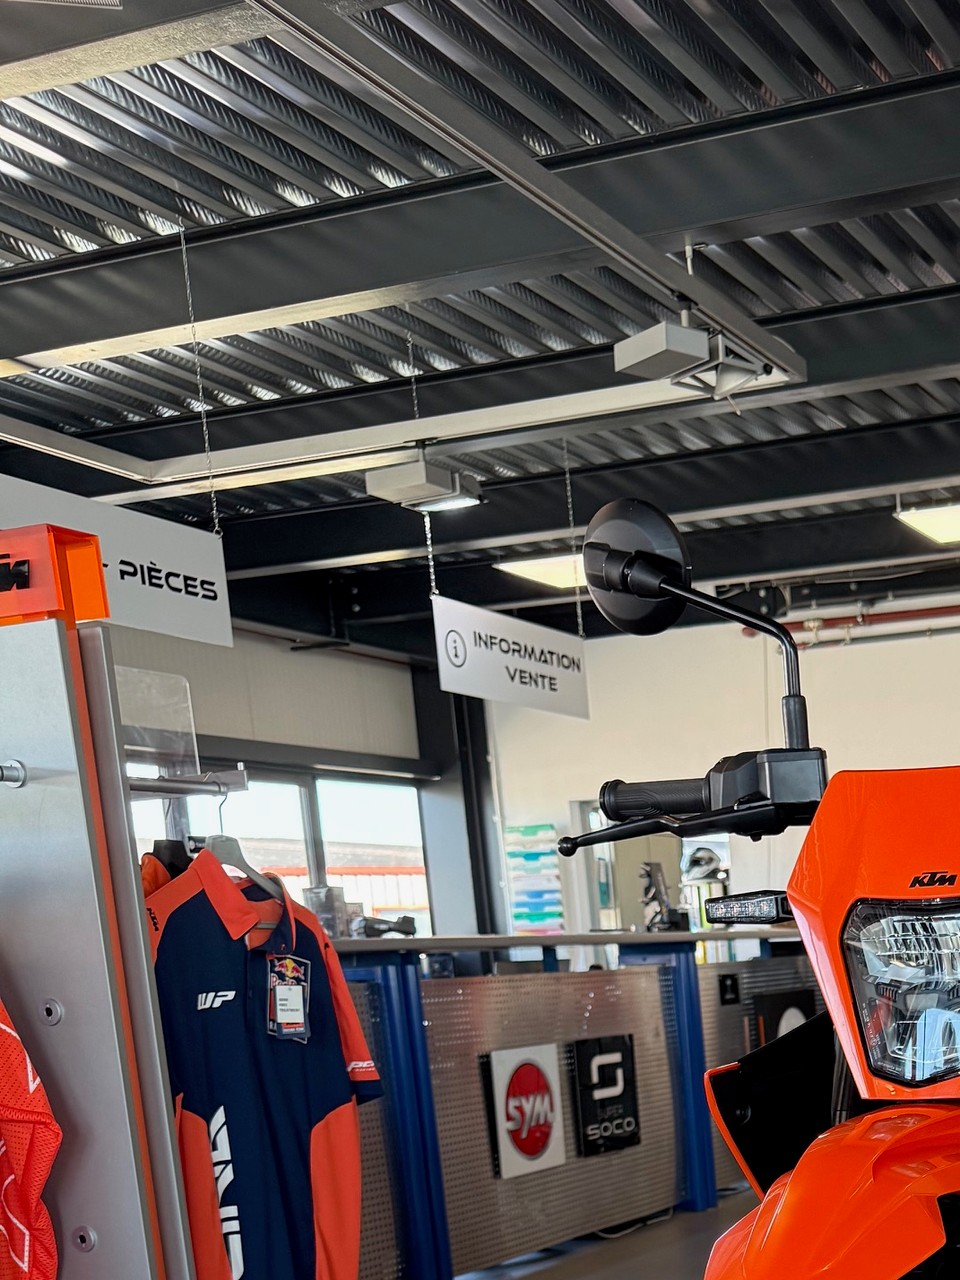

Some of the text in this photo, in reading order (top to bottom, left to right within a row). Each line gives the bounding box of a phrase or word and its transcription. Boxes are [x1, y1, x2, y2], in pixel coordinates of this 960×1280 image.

[118, 558, 219, 602] PIÈCES
[473, 630, 582, 673] INFORMATION
[505, 665, 559, 692] VENTE
[908, 871, 958, 888] KTM
[197, 990, 236, 1011] WP
[506, 1092, 556, 1140] SYM
[586, 1116, 636, 1141] SOCO
